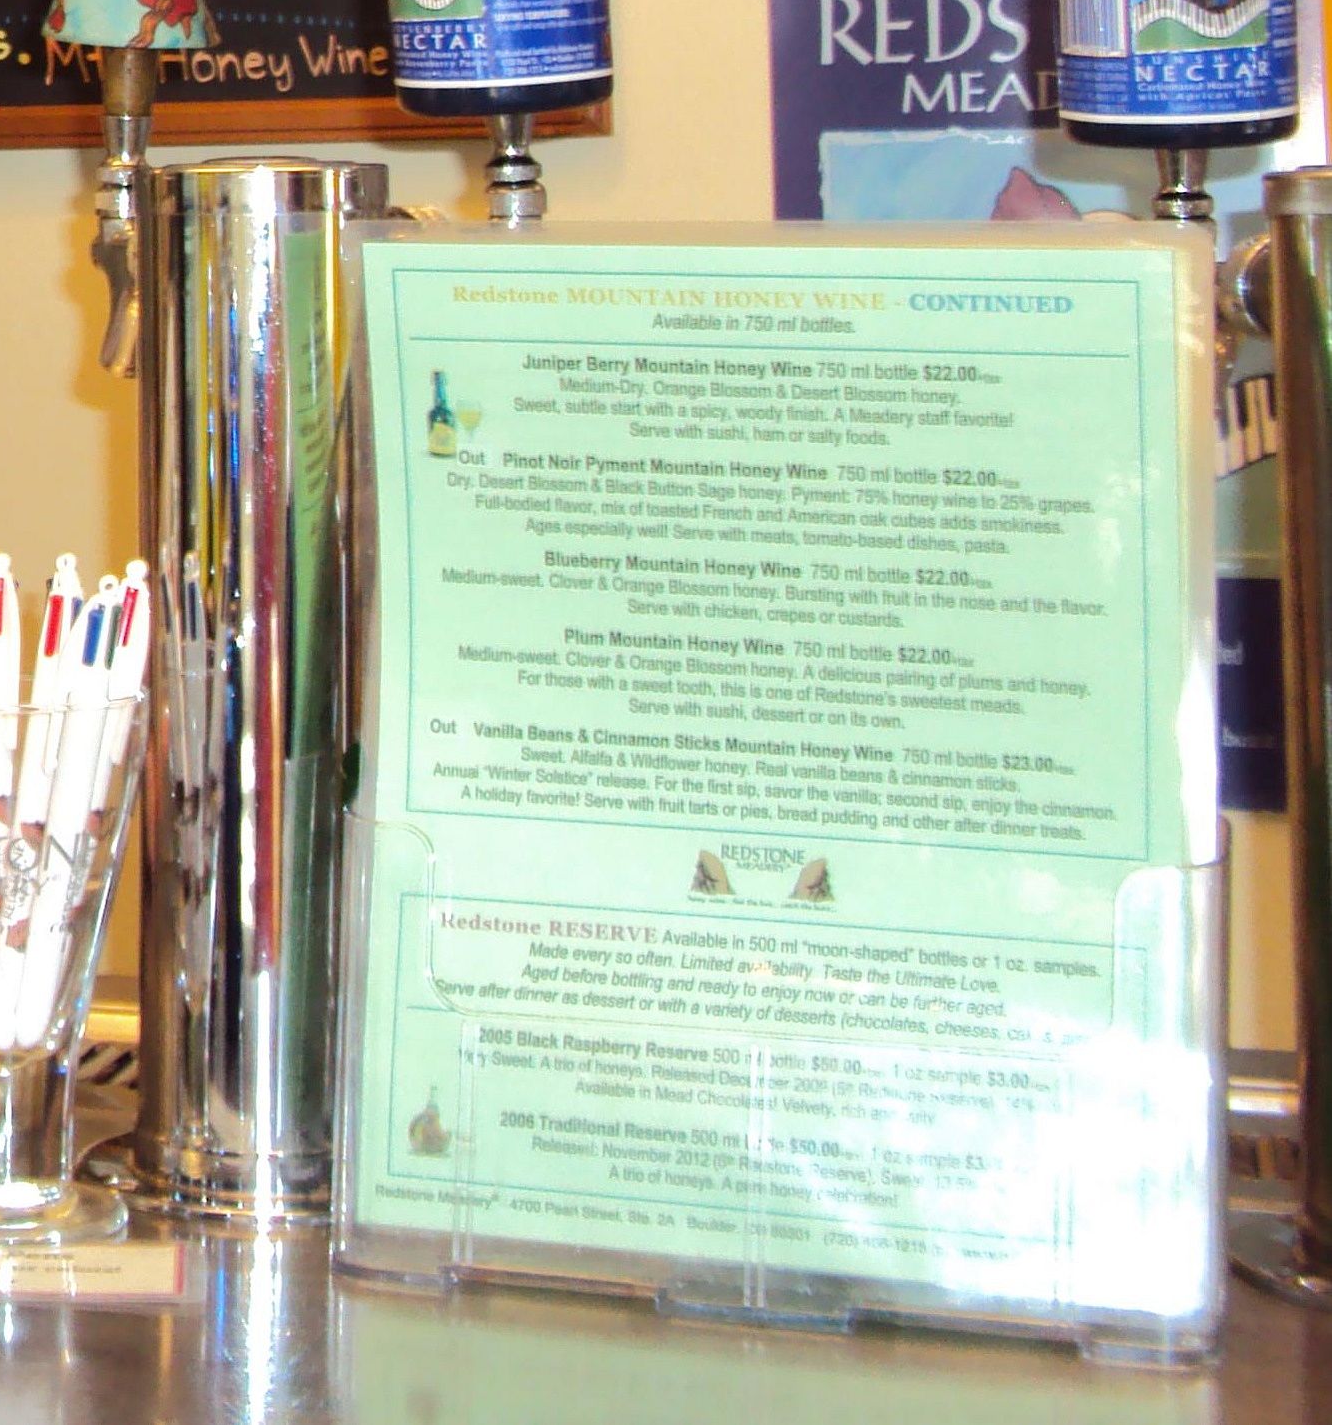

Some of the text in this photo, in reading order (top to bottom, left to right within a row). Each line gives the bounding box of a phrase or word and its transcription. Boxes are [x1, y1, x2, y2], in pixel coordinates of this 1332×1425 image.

[297, 34, 392, 77] Wine
[1135, 61, 1272, 83] NECTAR
[452, 284, 1075, 315] Redstone MOUNTAIN HONEY WINE CONTINUED
[522, 353, 813, 380] Juniper Berry Mountain Honey Wine
[458, 449, 487, 467] Out
[502, 452, 828, 482] Pinot Noir Pyment Mountain Honey Wine
[543, 550, 802, 580] Blueberry Mountain Honey Wine
[564, 627, 785, 657] Plum Mountain Honey Wine
[430, 717, 457, 735] Out
[473, 721, 722, 753] Vanilla Beans Cinnamon Sticks
[720, 843, 807, 865] REDSTONE
[440, 911, 659, 945] Redstone RESERVE
[479, 1027, 709, 1063] 2005 Black Raspberry Reserve
[499, 1111, 687, 1144] 2006 Traditional Reserve
